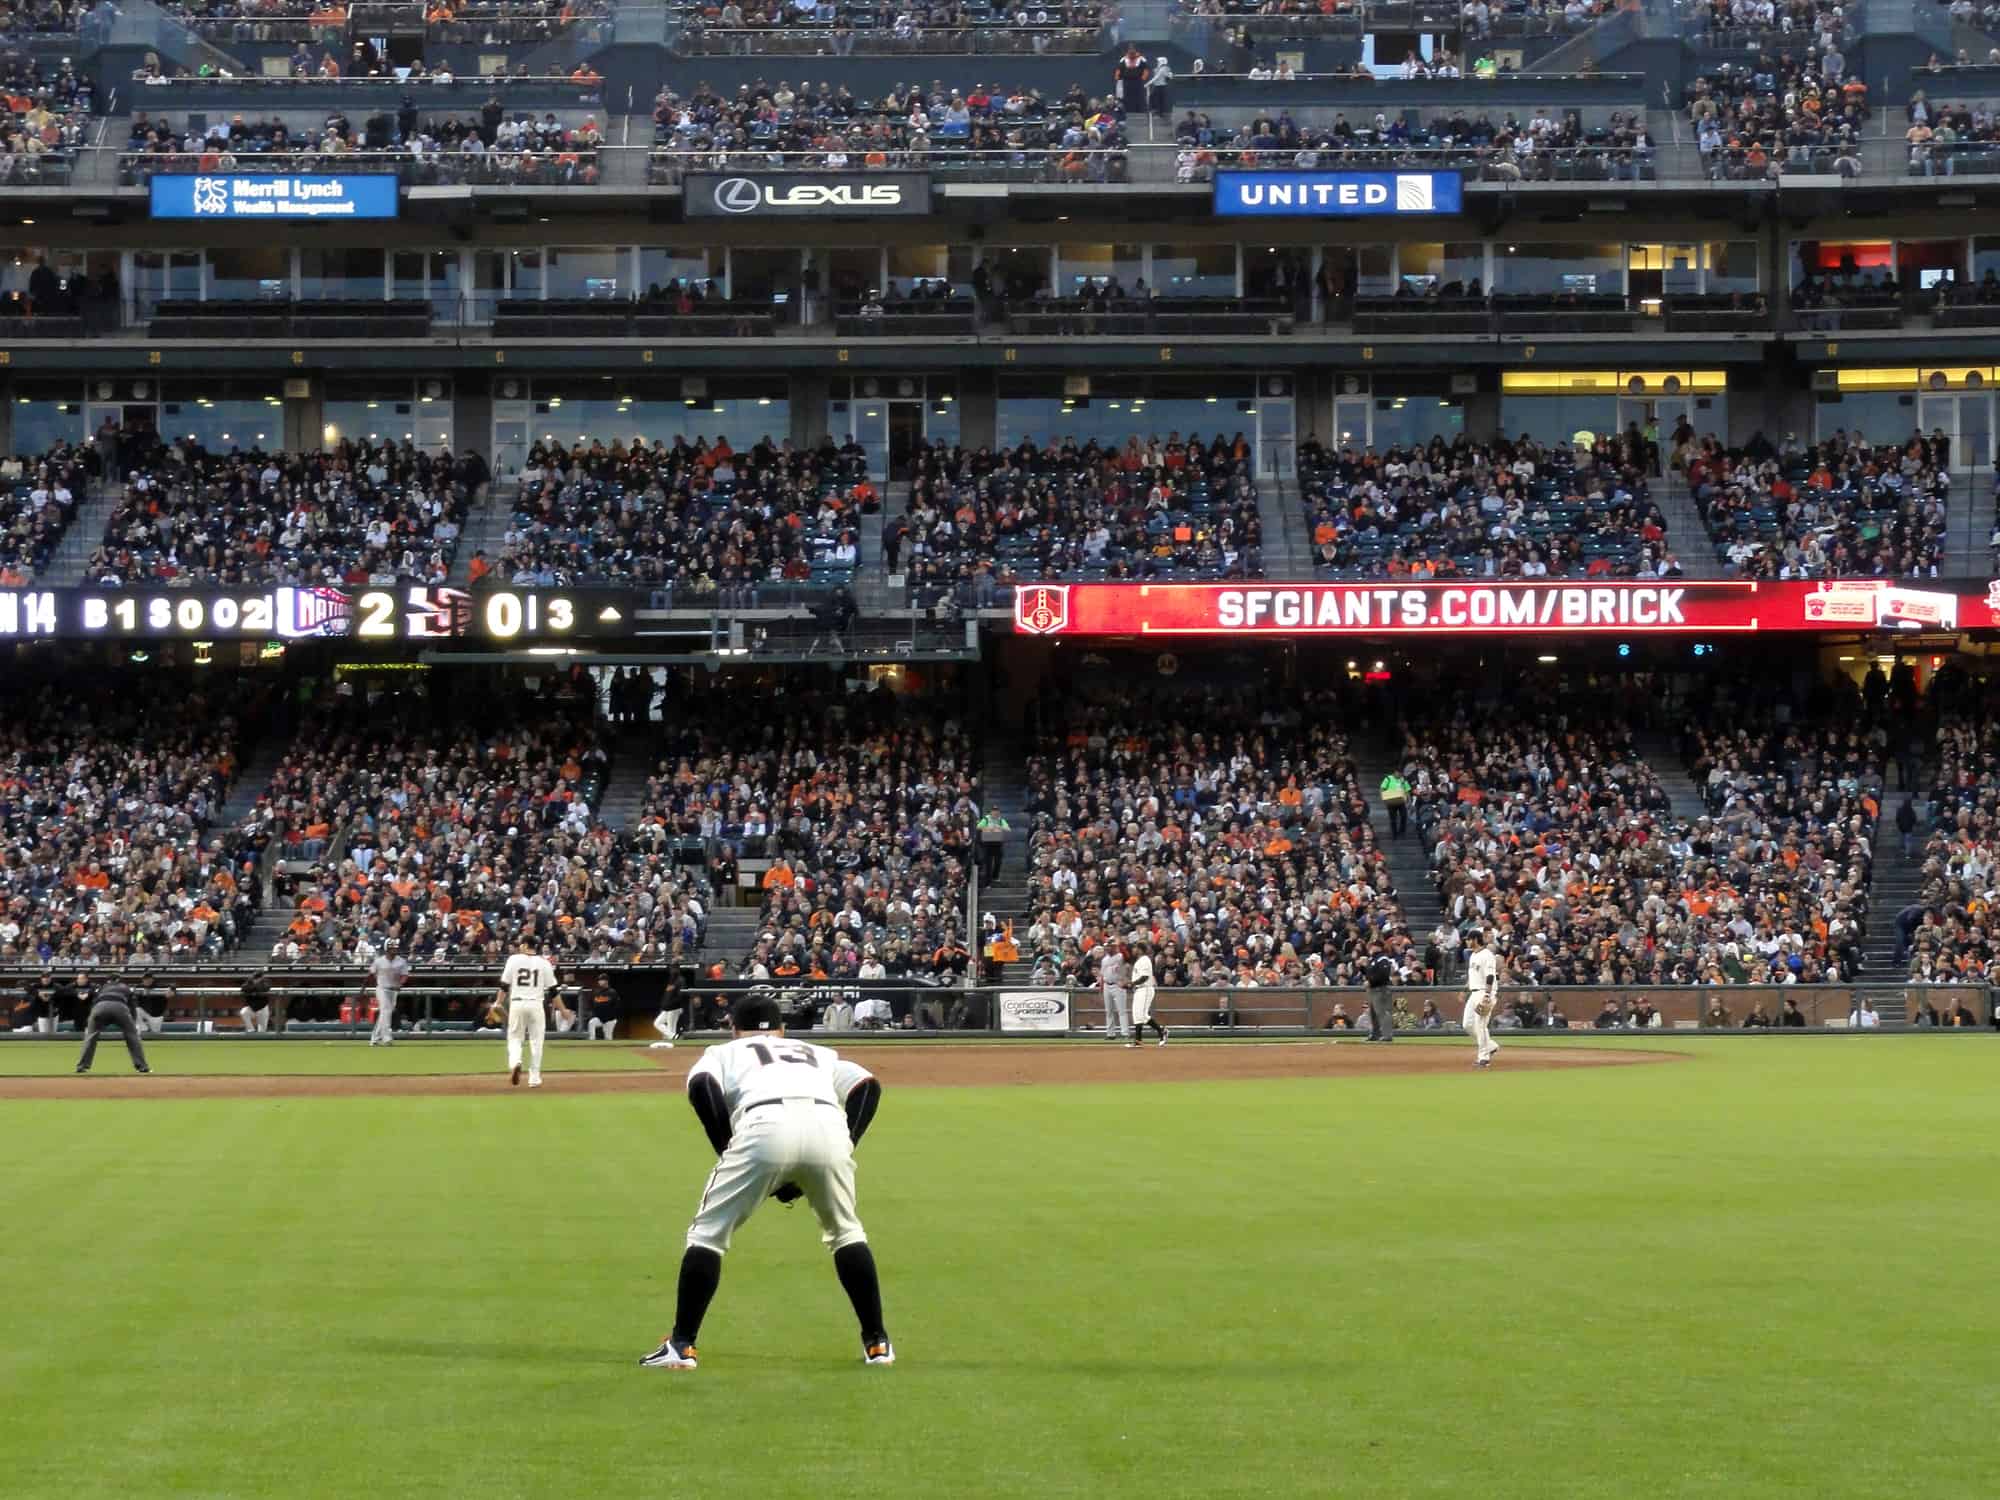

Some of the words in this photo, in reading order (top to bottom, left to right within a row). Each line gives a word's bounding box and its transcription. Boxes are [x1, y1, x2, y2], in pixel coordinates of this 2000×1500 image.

[233, 180, 289, 197] Merrill
[293, 180, 342, 200] Lynch
[765, 186, 901, 204] LEXUS
[1241, 185, 1388, 204] UNITED
[23, 592, 57, 633] 14
[358, 592, 395, 636] 2
[548, 599, 574, 629] 3
[1217, 588, 1686, 626] SFGIANTS.COM/BRICK
[517, 967, 539, 988] 21
[745, 1042, 819, 1069] 13
